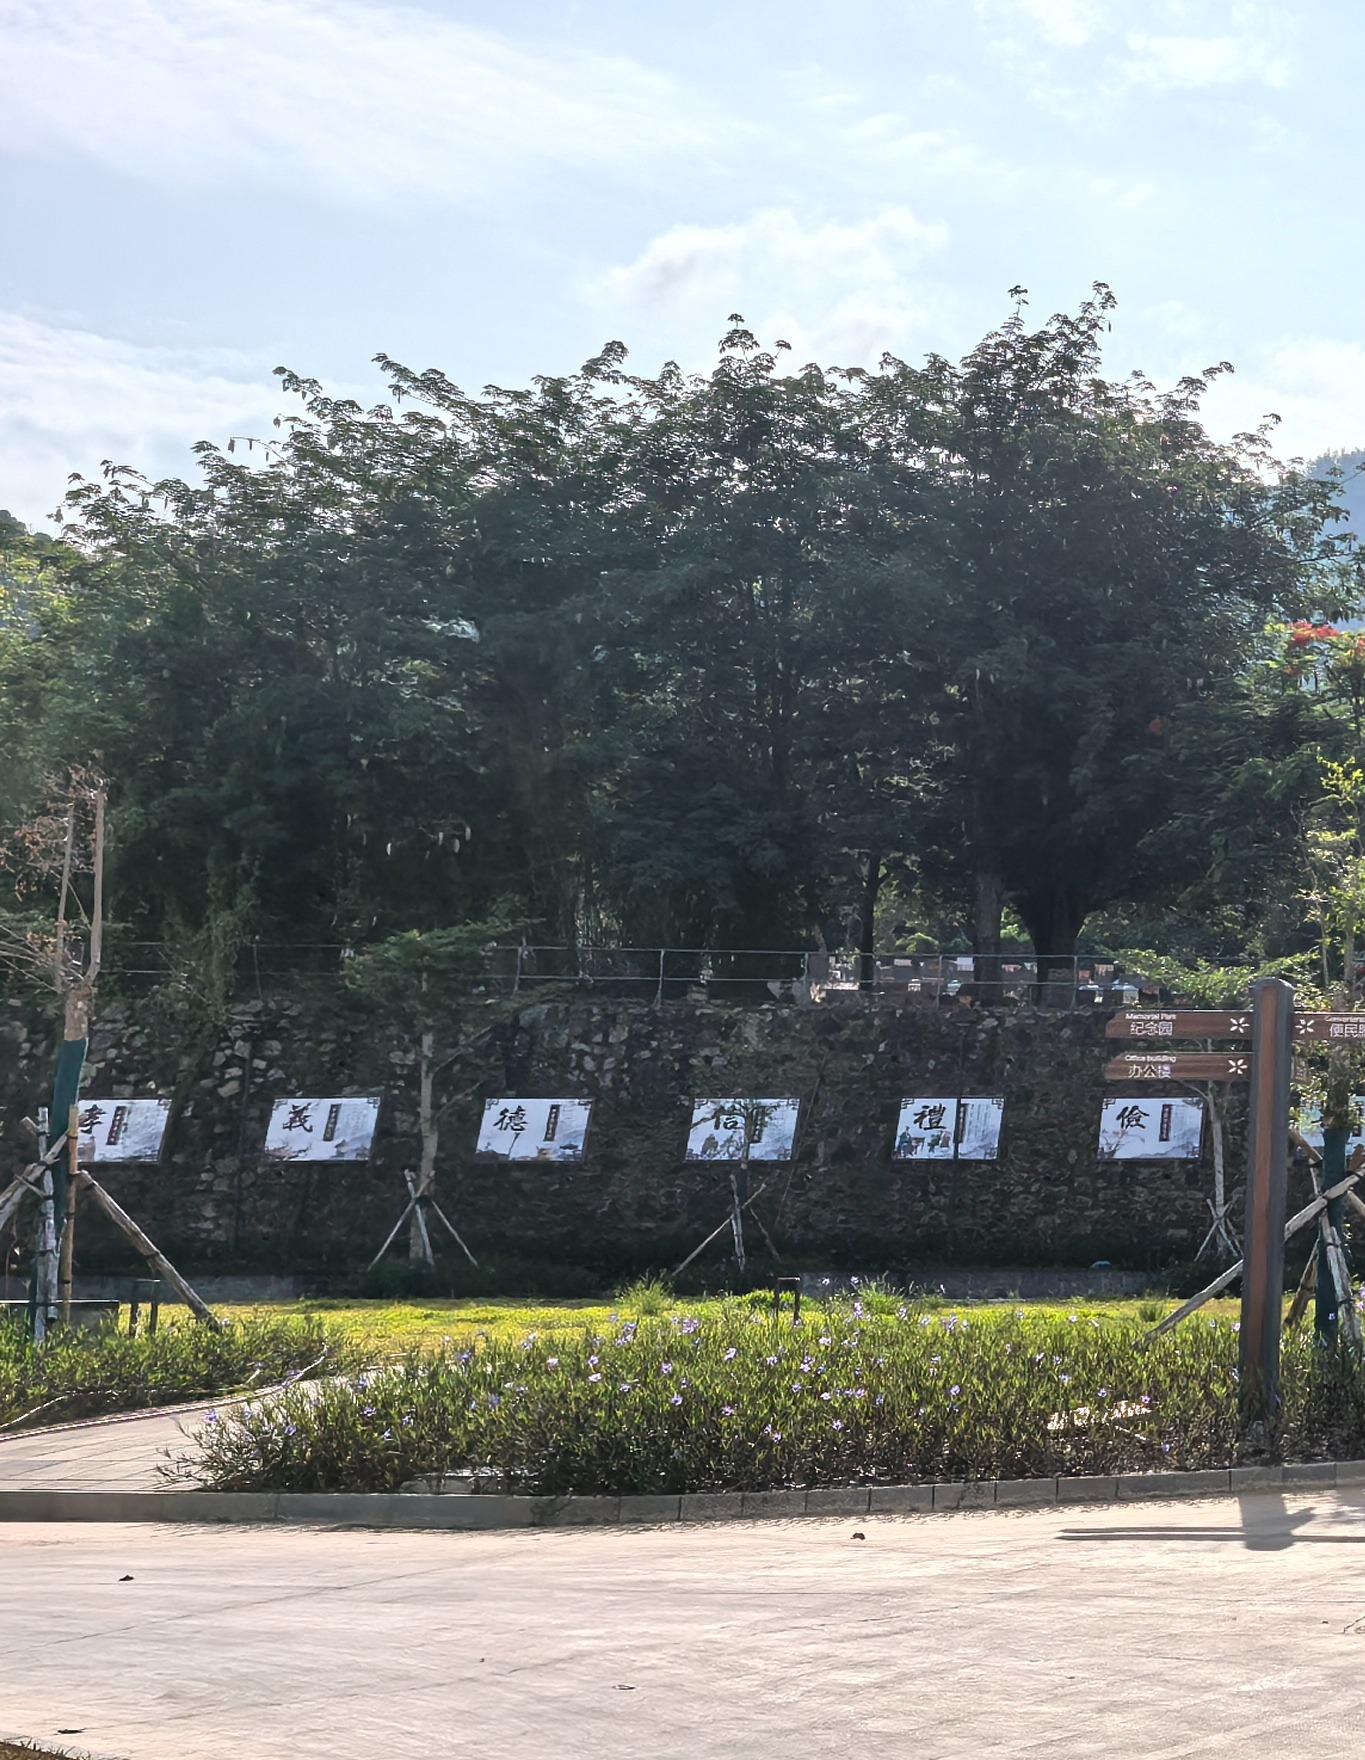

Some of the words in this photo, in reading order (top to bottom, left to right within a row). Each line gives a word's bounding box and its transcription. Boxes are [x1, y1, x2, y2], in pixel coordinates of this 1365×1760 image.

[1130, 1022, 1173, 1035] 纪念园
[1128, 1064, 1171, 1078] 办公楼
